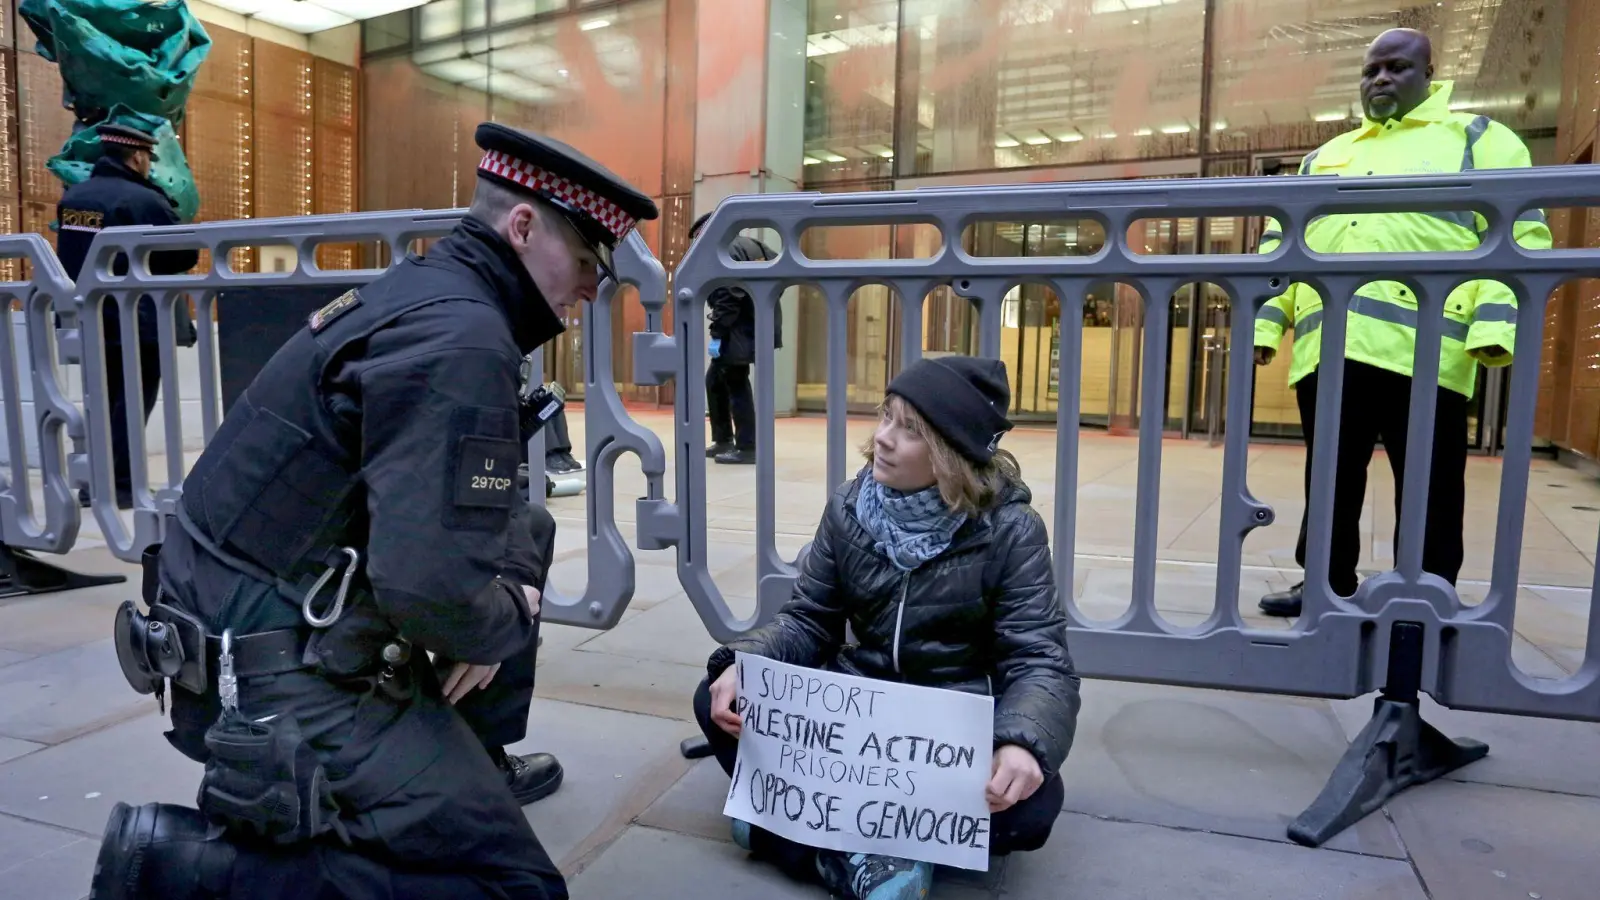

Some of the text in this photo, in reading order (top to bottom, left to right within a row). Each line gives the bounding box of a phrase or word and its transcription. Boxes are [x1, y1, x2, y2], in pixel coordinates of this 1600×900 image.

[62, 211, 104, 228] POLICE
[471, 475, 511, 490] 297CP
[485, 458, 495, 471] U
[739, 659, 885, 717] I SUPPORT
[736, 696, 975, 768] PALESTINE ACTION
[779, 744, 919, 796] PRISONERS
[730, 761, 990, 849] I OPPOSE GENOCIDE
